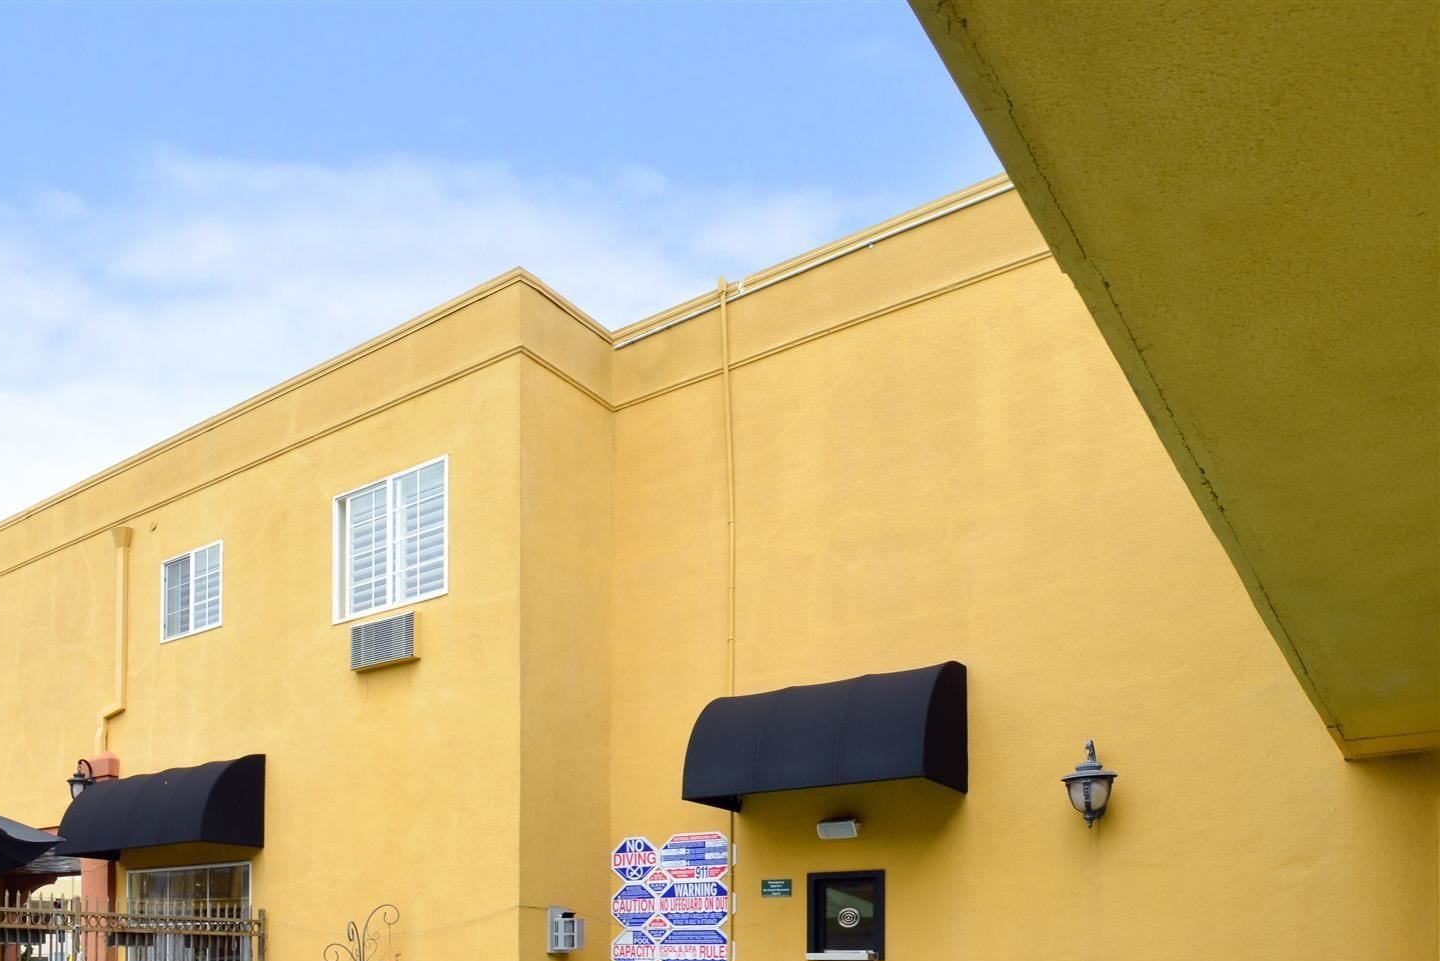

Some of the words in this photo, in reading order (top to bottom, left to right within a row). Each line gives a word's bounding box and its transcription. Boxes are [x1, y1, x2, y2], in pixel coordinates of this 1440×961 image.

[626, 840, 644, 852] NO
[613, 852, 657, 867] DIVING
[695, 866, 708, 879] 911
[674, 882, 718, 897] WARNING
[612, 898, 655, 913] CAUTION
[659, 898, 669, 911] NO
[670, 897, 703, 911] LIFEGUARD
[704, 897, 714, 911] ON
[633, 937, 651, 945] POOL
[613, 945, 656, 958] CAPACITY
[659, 945, 677, 953] POOL
[685, 945, 697, 953] SPA
[699, 945, 728, 959] RULE
